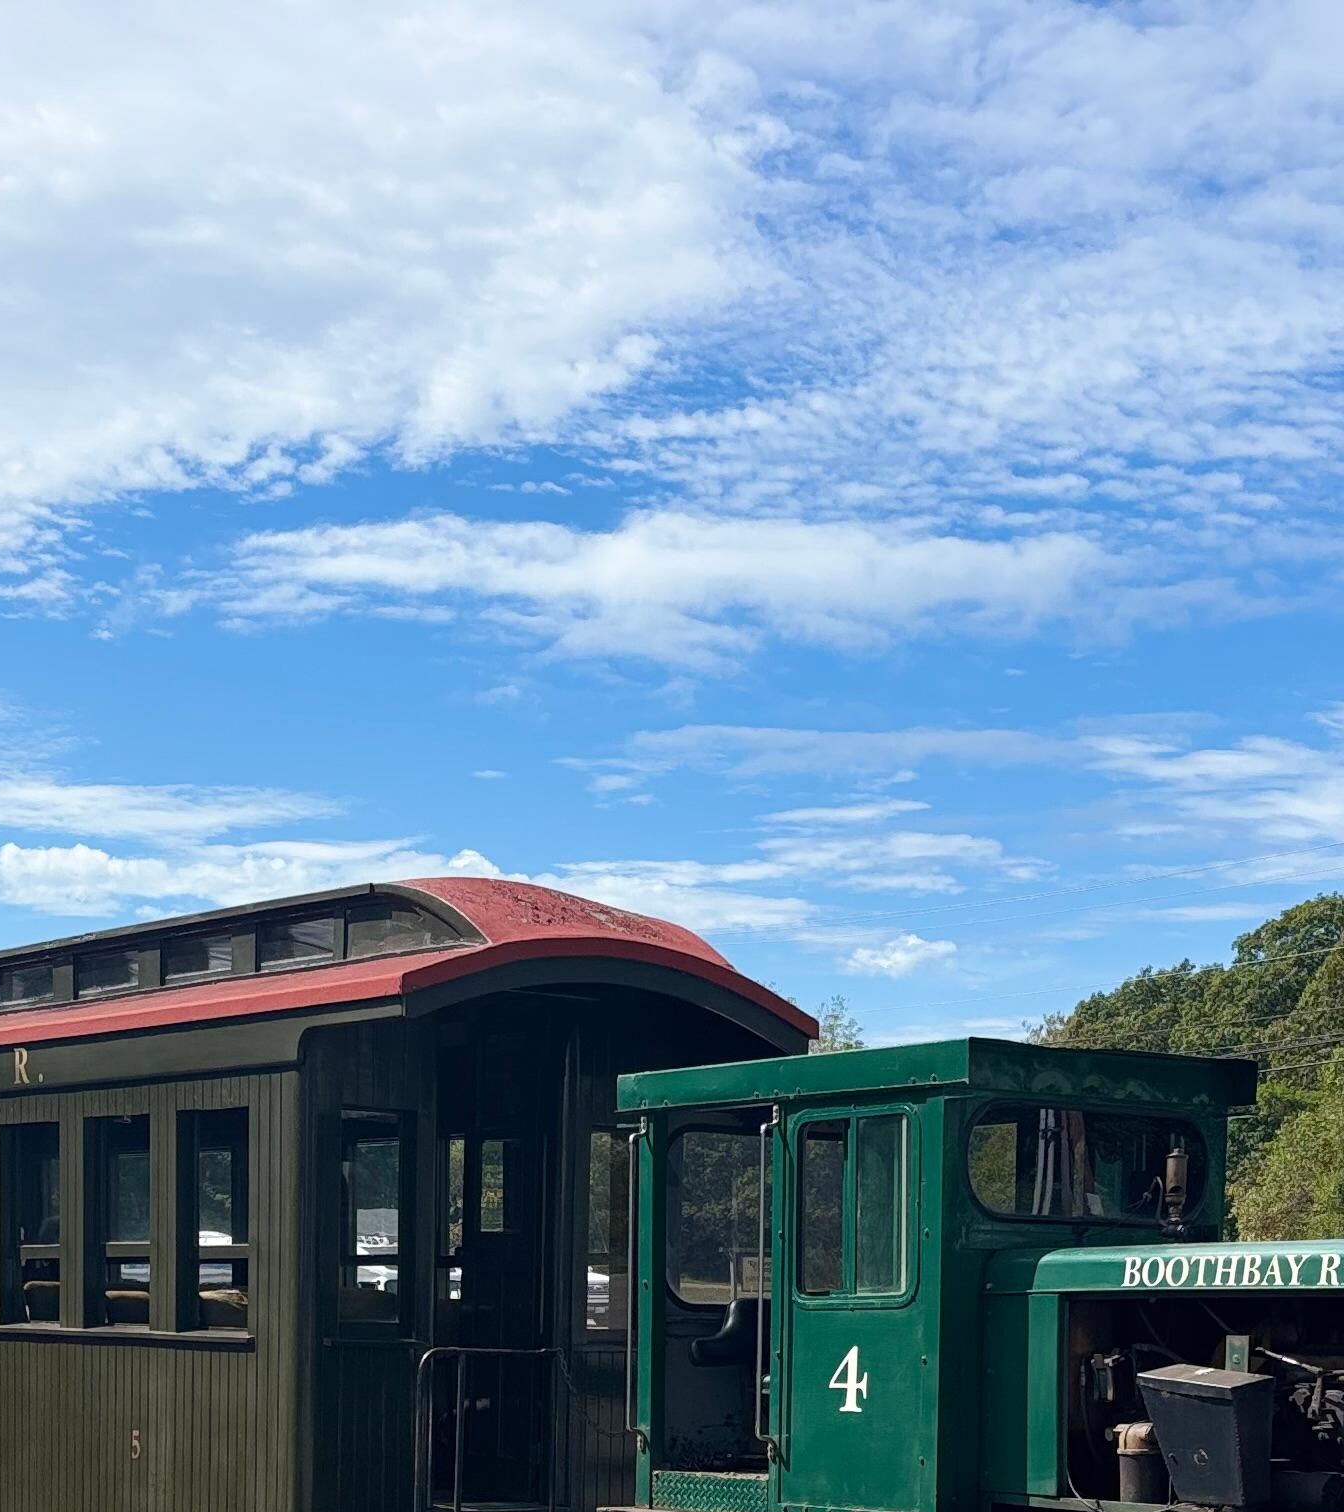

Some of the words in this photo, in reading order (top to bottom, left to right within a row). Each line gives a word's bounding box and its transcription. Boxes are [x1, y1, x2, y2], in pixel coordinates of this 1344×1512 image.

[13, 1048, 44, 1085] R.
[1121, 1254, 1312, 1288] BOOTHBAY
[828, 1345, 868, 1413] 4
[131, 1430, 141, 1459] 5
